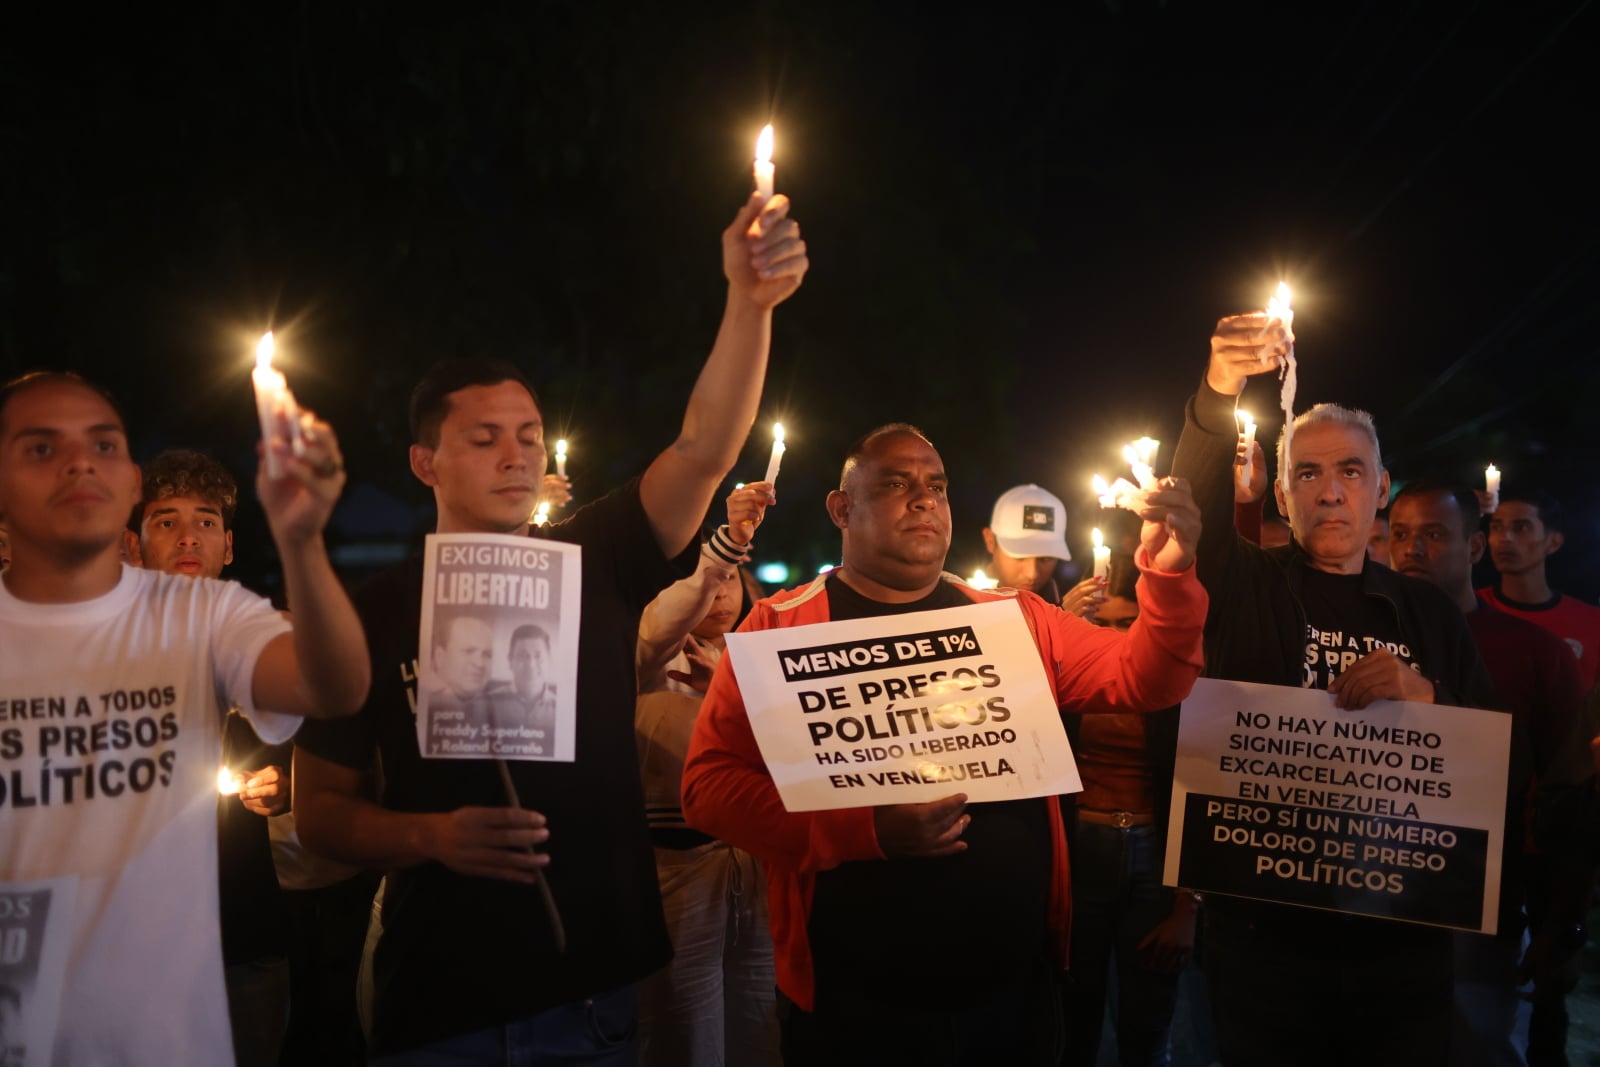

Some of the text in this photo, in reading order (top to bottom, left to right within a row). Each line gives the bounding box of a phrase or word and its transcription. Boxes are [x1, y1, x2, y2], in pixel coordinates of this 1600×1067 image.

[440, 546, 550, 571] EXIGIMOS
[436, 572, 550, 610] LIBERTAD
[783, 631, 976, 676] MENOS DE 1%
[1347, 636, 1359, 650] A
[74, 695, 92, 717] A
[100, 686, 176, 713] TODOS
[797, 686, 851, 714] DE
[38, 712, 179, 757] PRESOS
[807, 696, 1011, 747] POLÍTICOS
[1235, 711, 1442, 750] NO HAY NÚMERO
[815, 728, 1017, 766] HA SIDO LIBERADO
[1229, 733, 1445, 774] SIGNIFICATIVO DE
[0, 750, 176, 809] LÍTICOS
[829, 774, 866, 789] EN
[1219, 755, 1452, 799] EXCARCELACIONES
[1239, 781, 1421, 820] EN VENEZUELA
[1207, 800, 1458, 849] PERO SÍ UN NÚMERO
[1213, 824, 1447, 872] DOLORO DE PRESO
[1256, 855, 1404, 895] POLÍTICOS
